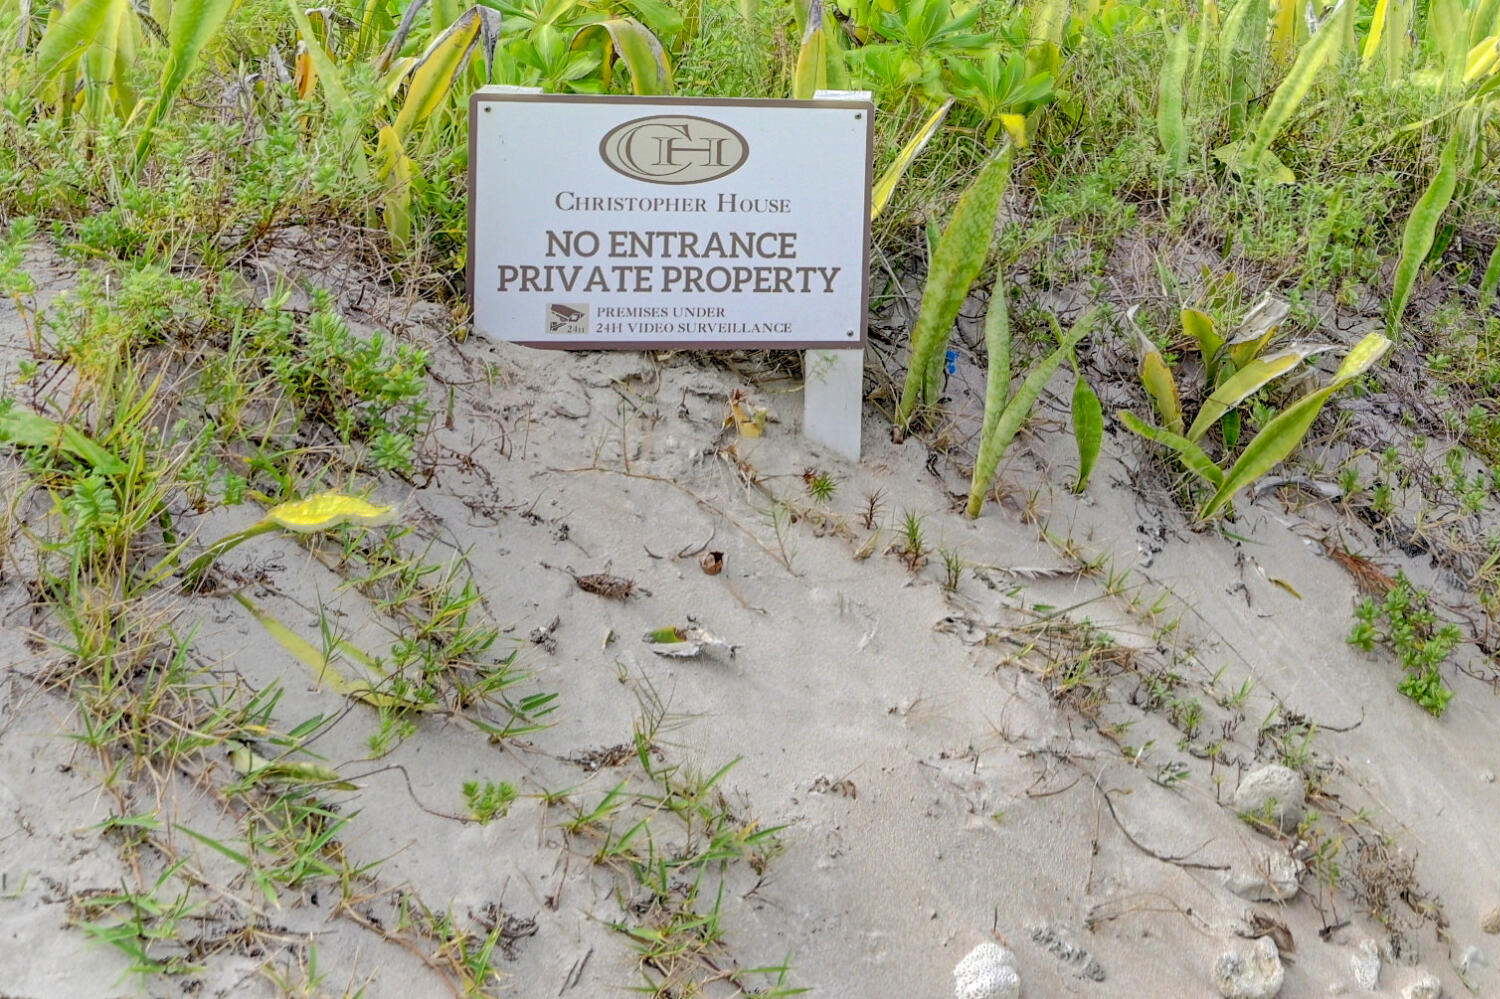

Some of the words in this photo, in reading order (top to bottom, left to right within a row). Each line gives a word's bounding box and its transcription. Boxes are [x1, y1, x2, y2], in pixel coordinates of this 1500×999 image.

[555, 191, 707, 213] CHRISTOPHER
[717, 193, 792, 214] HOUSE
[545, 230, 600, 258] NO
[608, 231, 797, 259] ENTRANCE
[497, 265, 653, 293] PRIVATE
[661, 266, 842, 293] PROPERTY
[597, 307, 669, 318] PREMISES
[673, 307, 726, 318] UNDER
[596, 322, 622, 333] 24H
[627, 322, 674, 333] VIDEO
[678, 322, 792, 334] SURVEILLANCE
